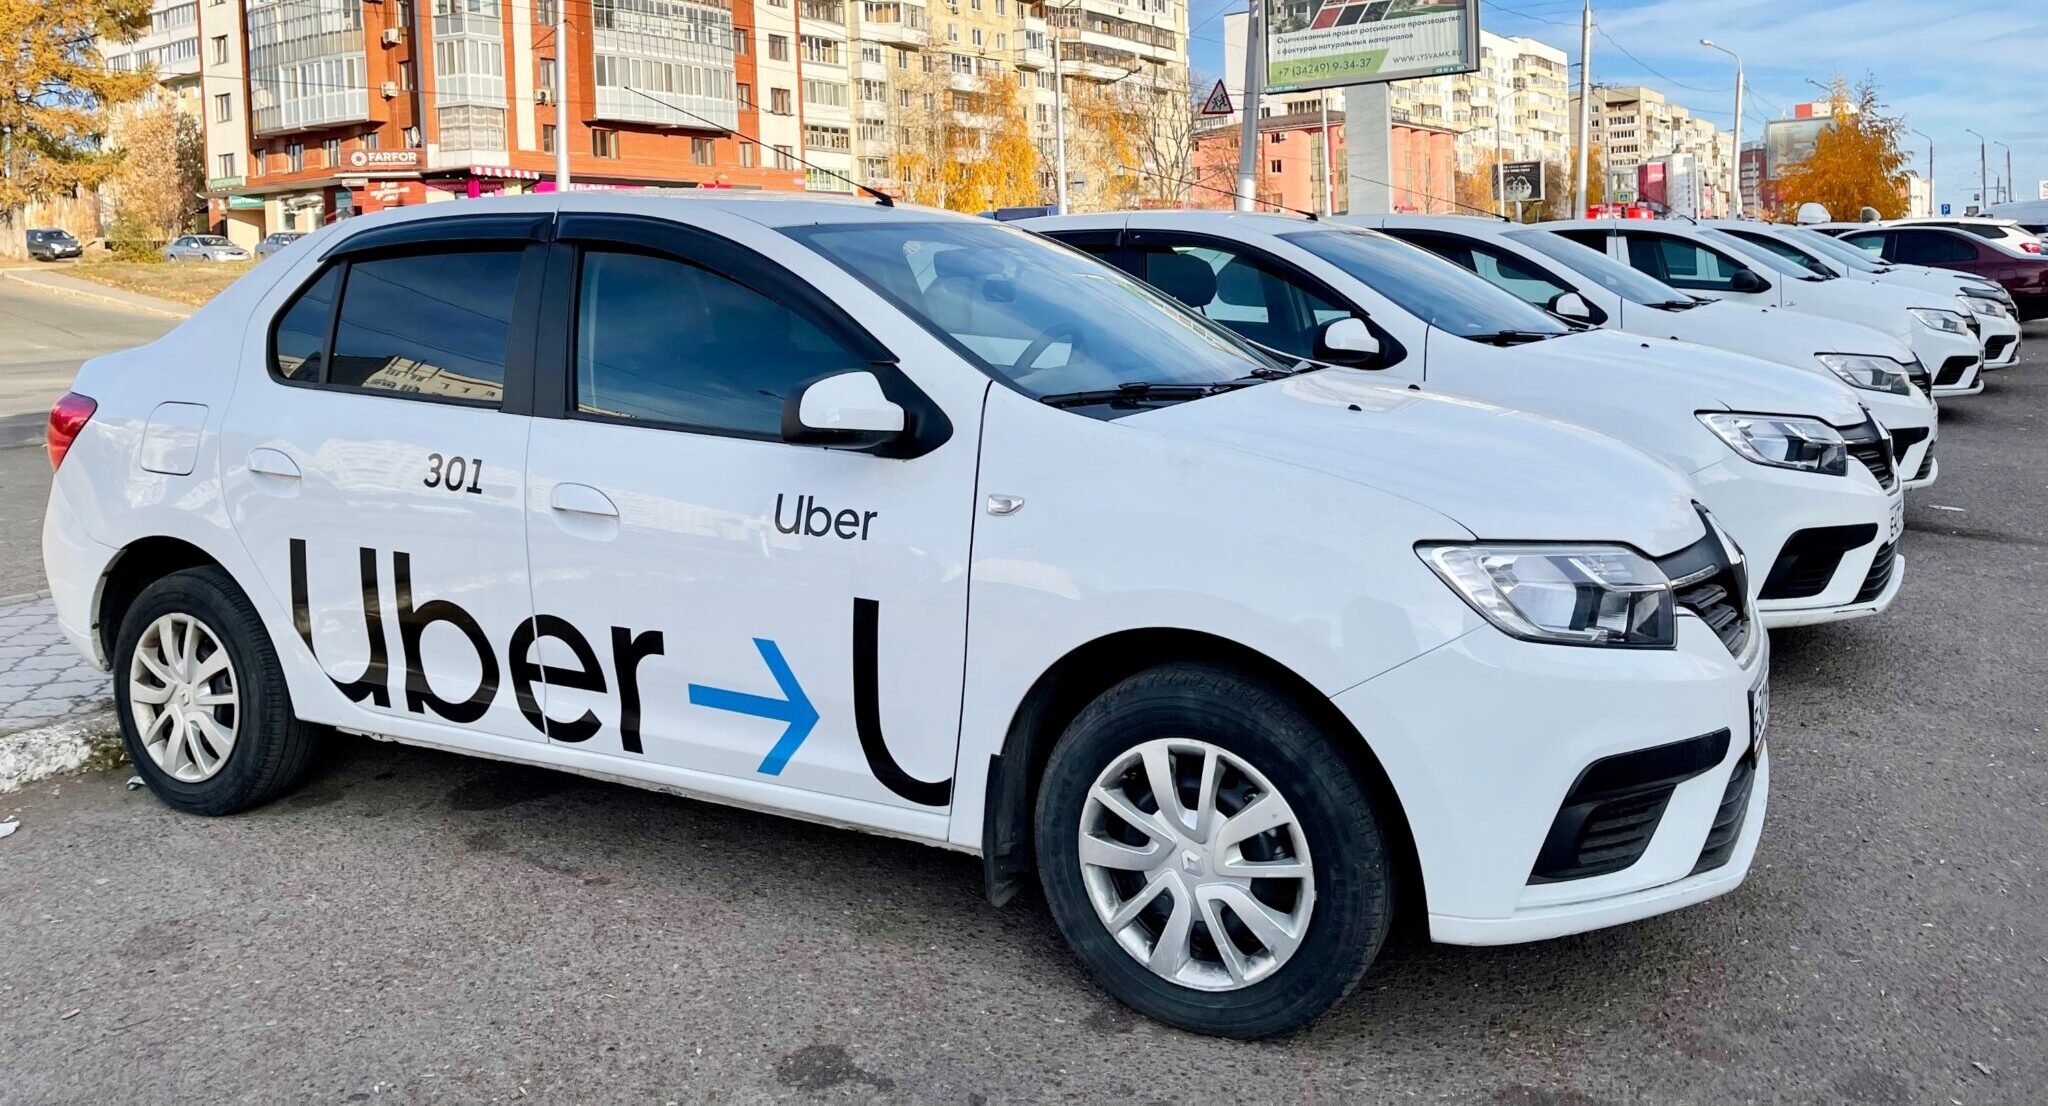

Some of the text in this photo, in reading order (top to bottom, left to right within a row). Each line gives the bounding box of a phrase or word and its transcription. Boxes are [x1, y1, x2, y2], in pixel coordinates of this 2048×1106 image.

[1277, 15, 1461, 44] Оцинкованный прокат российского производства
[1282, 45, 1317, 56] фактурой
[1318, 39, 1367, 50] натуральных
[1368, 33, 1414, 44] материалов
[1392, 49, 1463, 64] WWW.LYSVAMK.RU
[1278, 57, 1372, 78] +7 (34249) 9-34-37
[368, 151, 417, 162] FARFOR
[423, 453, 483, 494] 301
[774, 493, 878, 541] Uber
[289, 537, 665, 754] Uber
